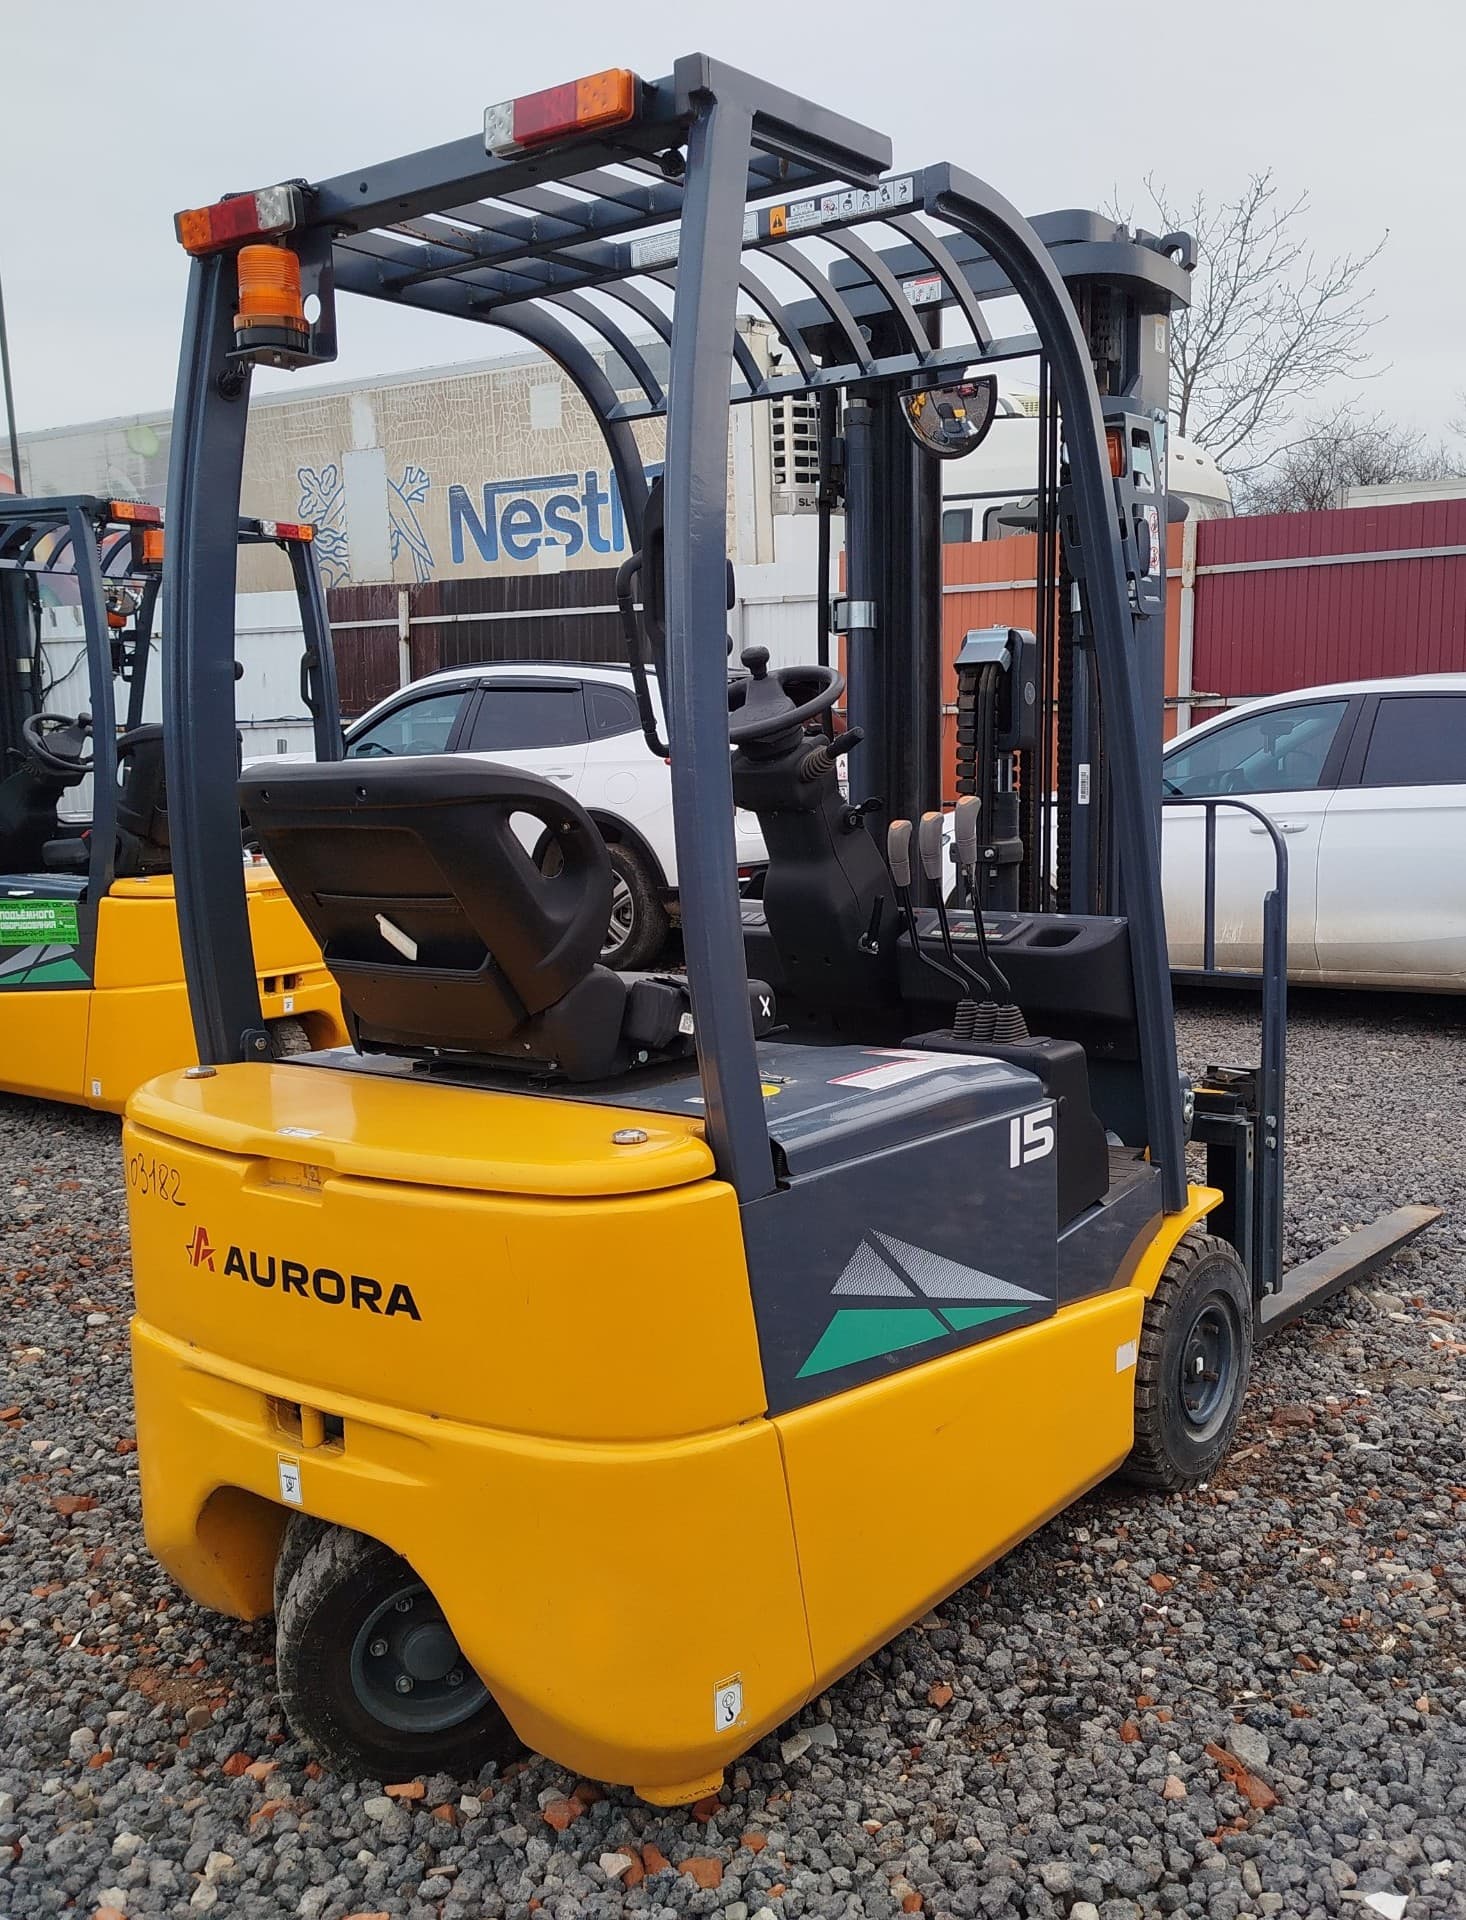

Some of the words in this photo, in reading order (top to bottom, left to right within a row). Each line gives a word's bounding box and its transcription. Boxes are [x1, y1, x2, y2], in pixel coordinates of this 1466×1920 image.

[449, 468, 632, 564] Nestl
[1009, 1106, 1055, 1169] 15
[130, 1152, 187, 1207] 03182
[223, 1245, 423, 1322] AURORA
